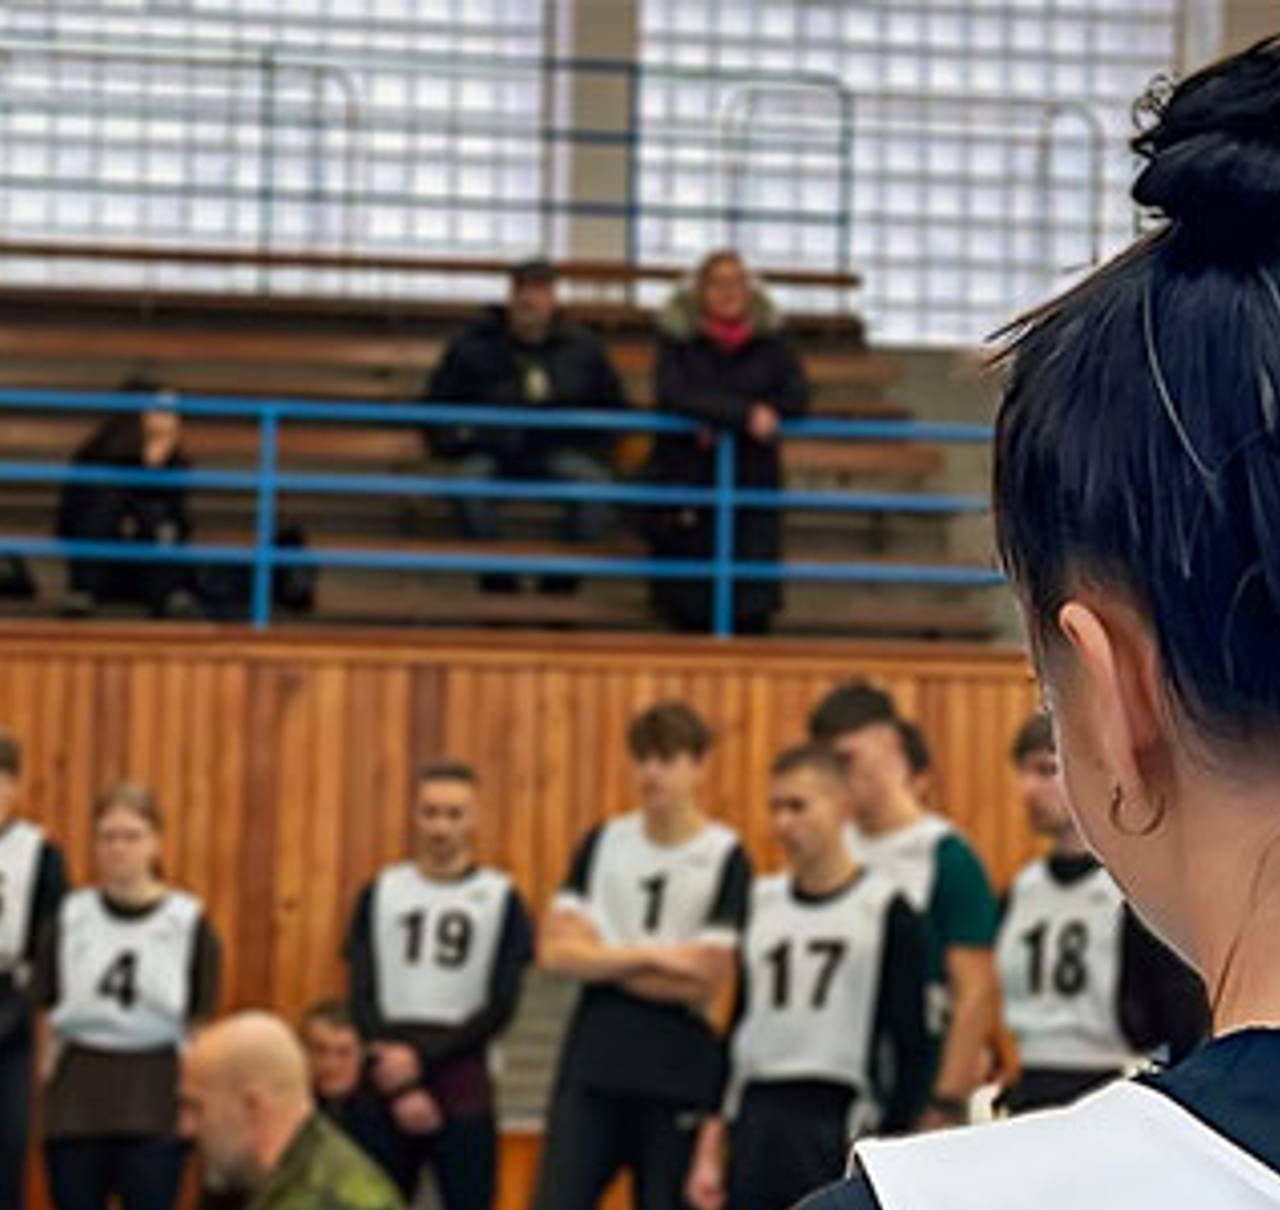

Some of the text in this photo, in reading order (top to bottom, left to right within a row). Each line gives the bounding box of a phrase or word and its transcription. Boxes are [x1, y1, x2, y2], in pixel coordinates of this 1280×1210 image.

[641, 874, 668, 934] 1
[400, 909, 476, 971] 19
[1021, 919, 1089, 1000] 18
[96, 950, 141, 1012] 4
[764, 938, 852, 1012] 17
